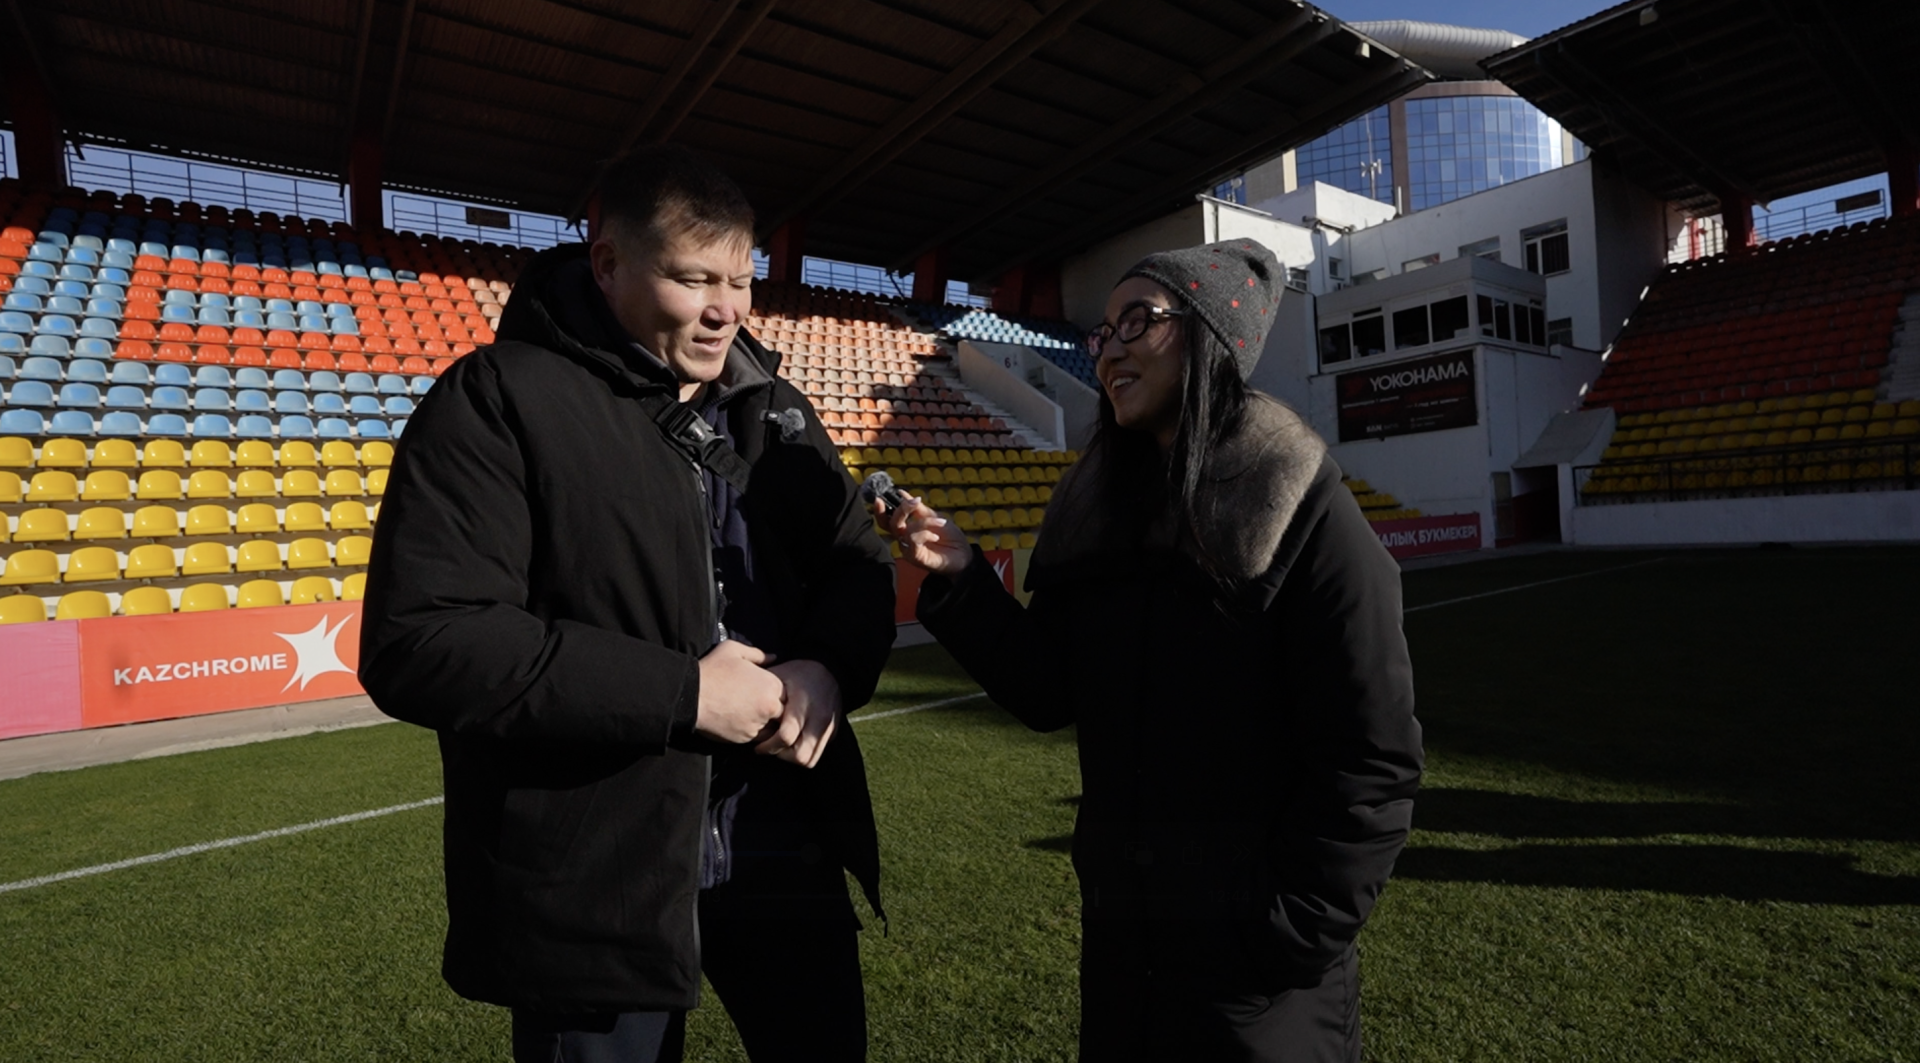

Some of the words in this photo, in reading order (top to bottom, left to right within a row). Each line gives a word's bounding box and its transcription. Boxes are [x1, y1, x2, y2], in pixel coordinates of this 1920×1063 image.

[1004, 357, 1012, 369] 6
[1369, 360, 1469, 392] YOKOHAMA
[1418, 525, 1478, 543] БУКМЕКЕРІ
[113, 653, 288, 686] KAZCHROME
